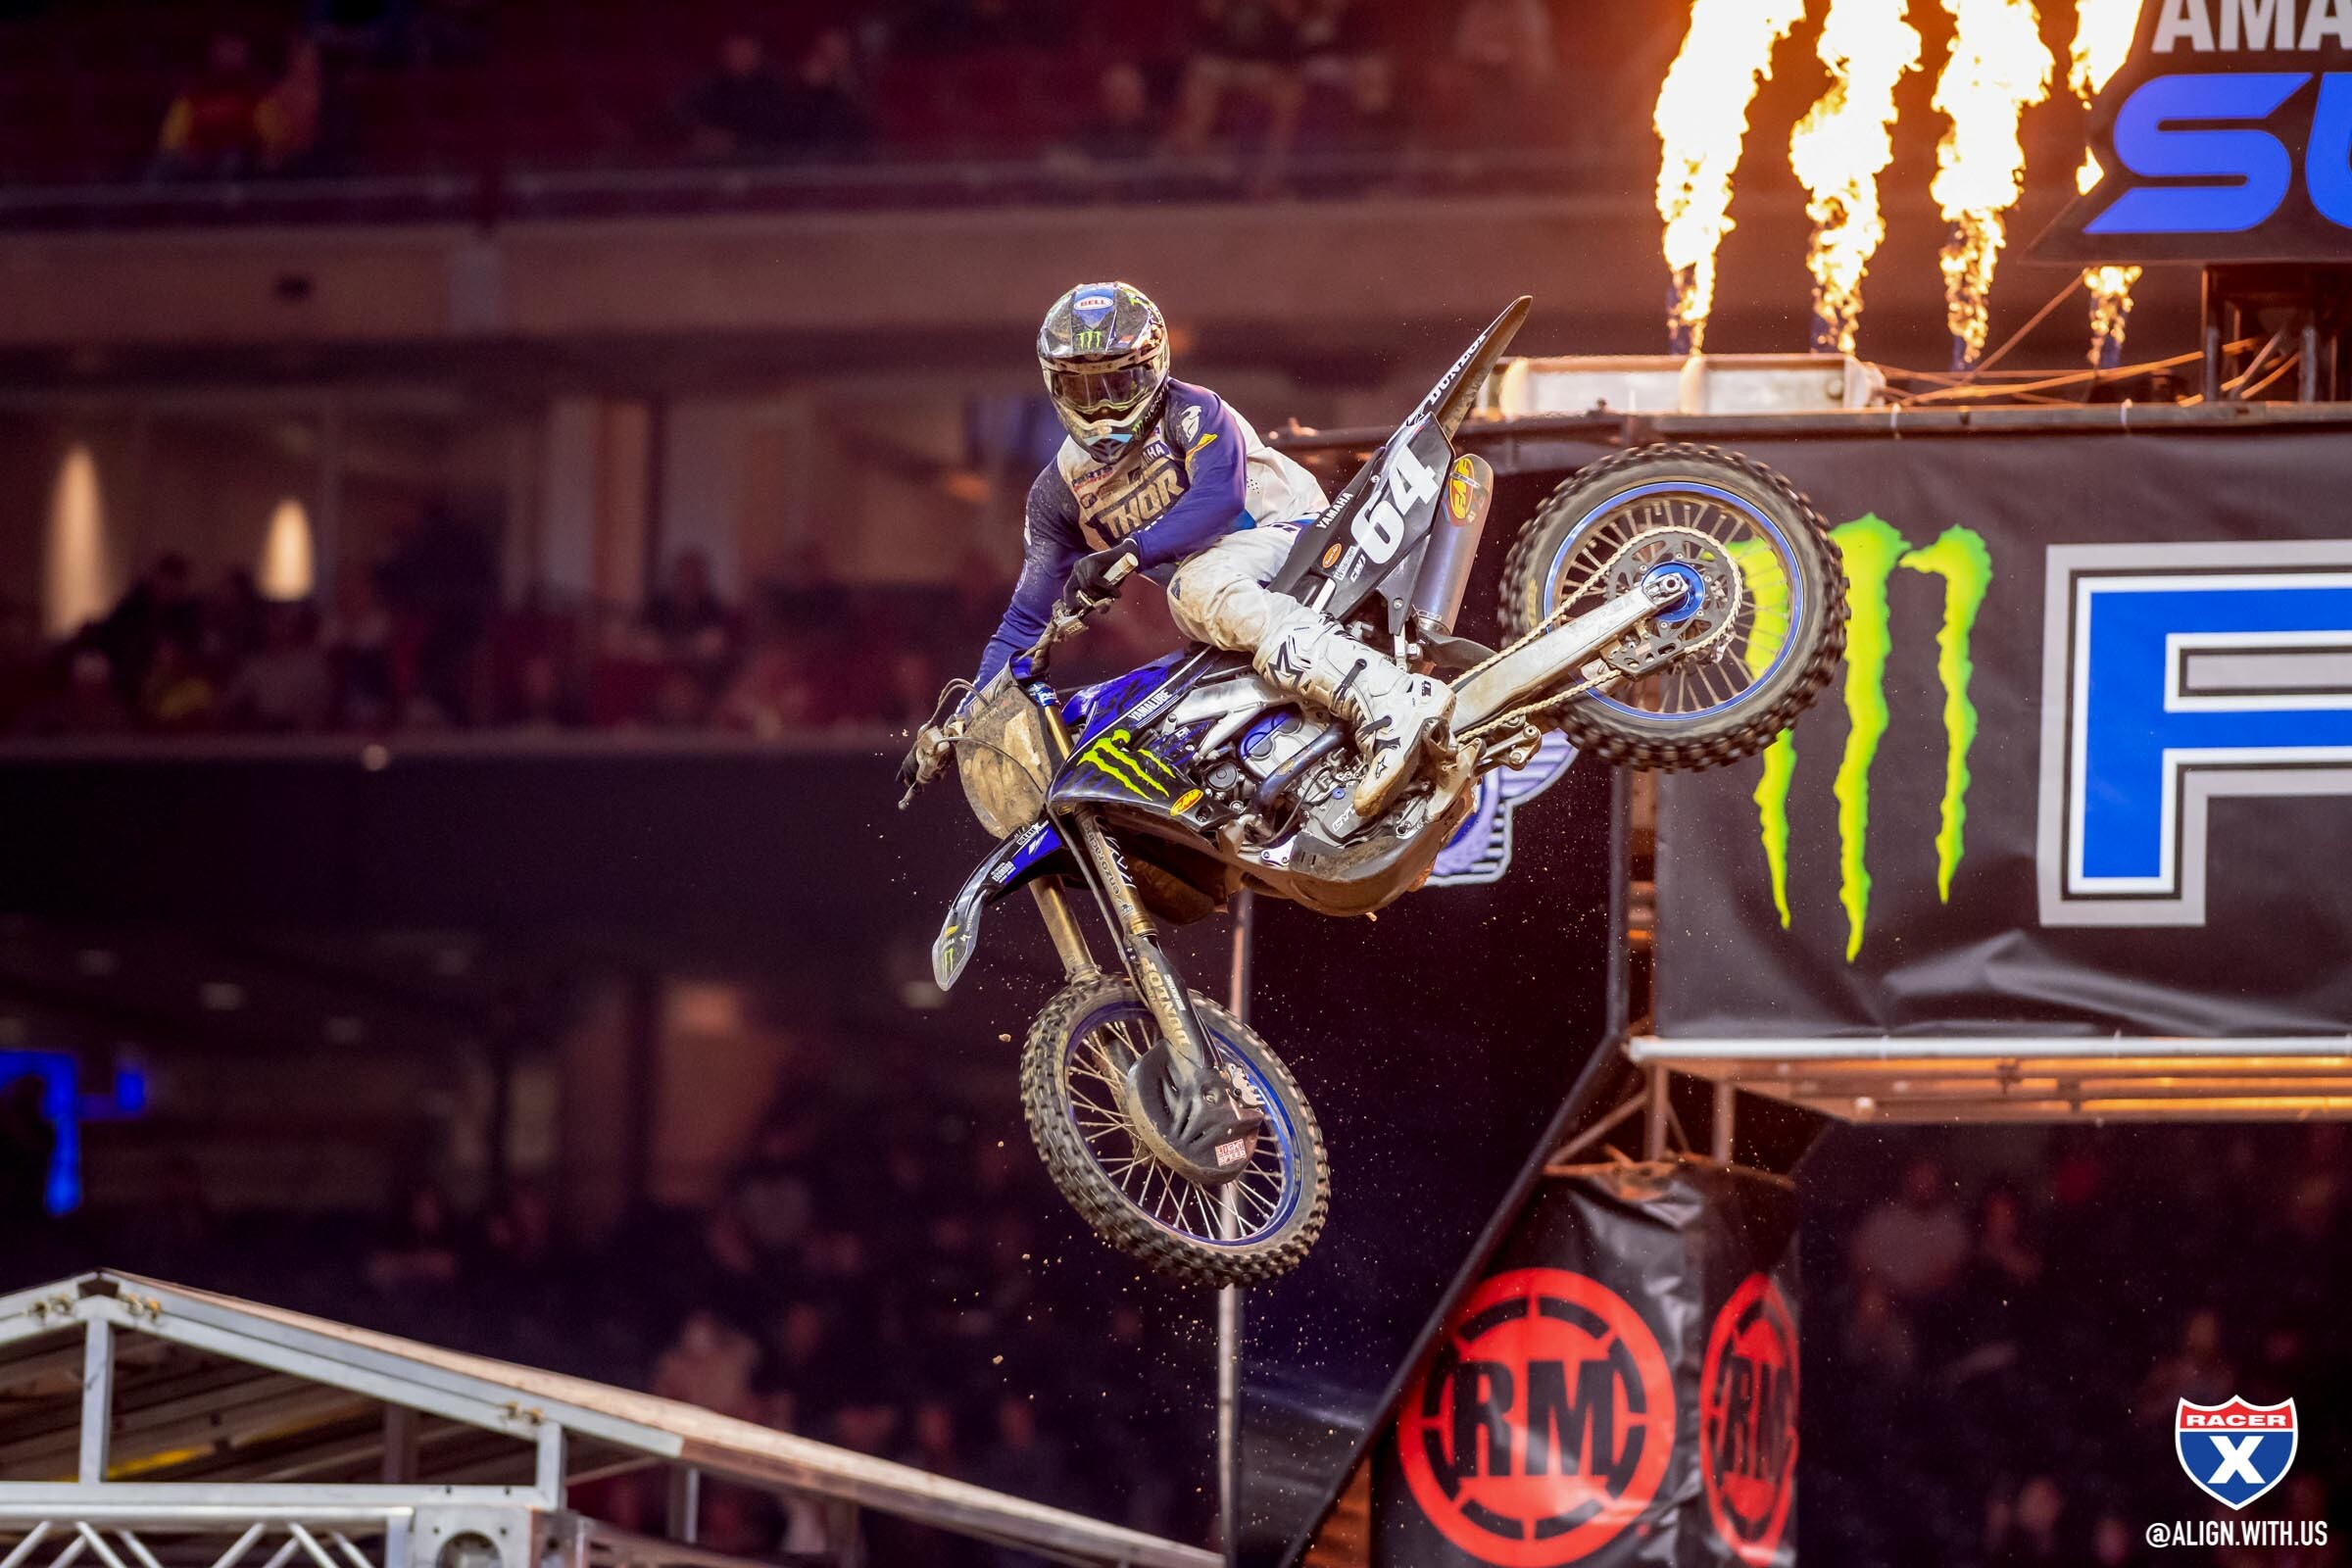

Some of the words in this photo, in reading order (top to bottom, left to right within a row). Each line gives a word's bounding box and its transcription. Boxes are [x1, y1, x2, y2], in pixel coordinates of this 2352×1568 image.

[2082, 72, 2352, 234] S
[1080, 299, 1105, 308] BELL
[1099, 467, 1185, 539] THOR
[1315, 491, 1354, 529] YAMAHA
[1350, 444, 1440, 564] 64
[1128, 688, 1173, 721] YAMALUBE
[1140, 956, 1192, 1046] DUNLOP
[1216, 1139, 1244, 1155] LIGHT
[1218, 1150, 1247, 1166] SPEED
[1452, 1359, 1615, 1477] RM
